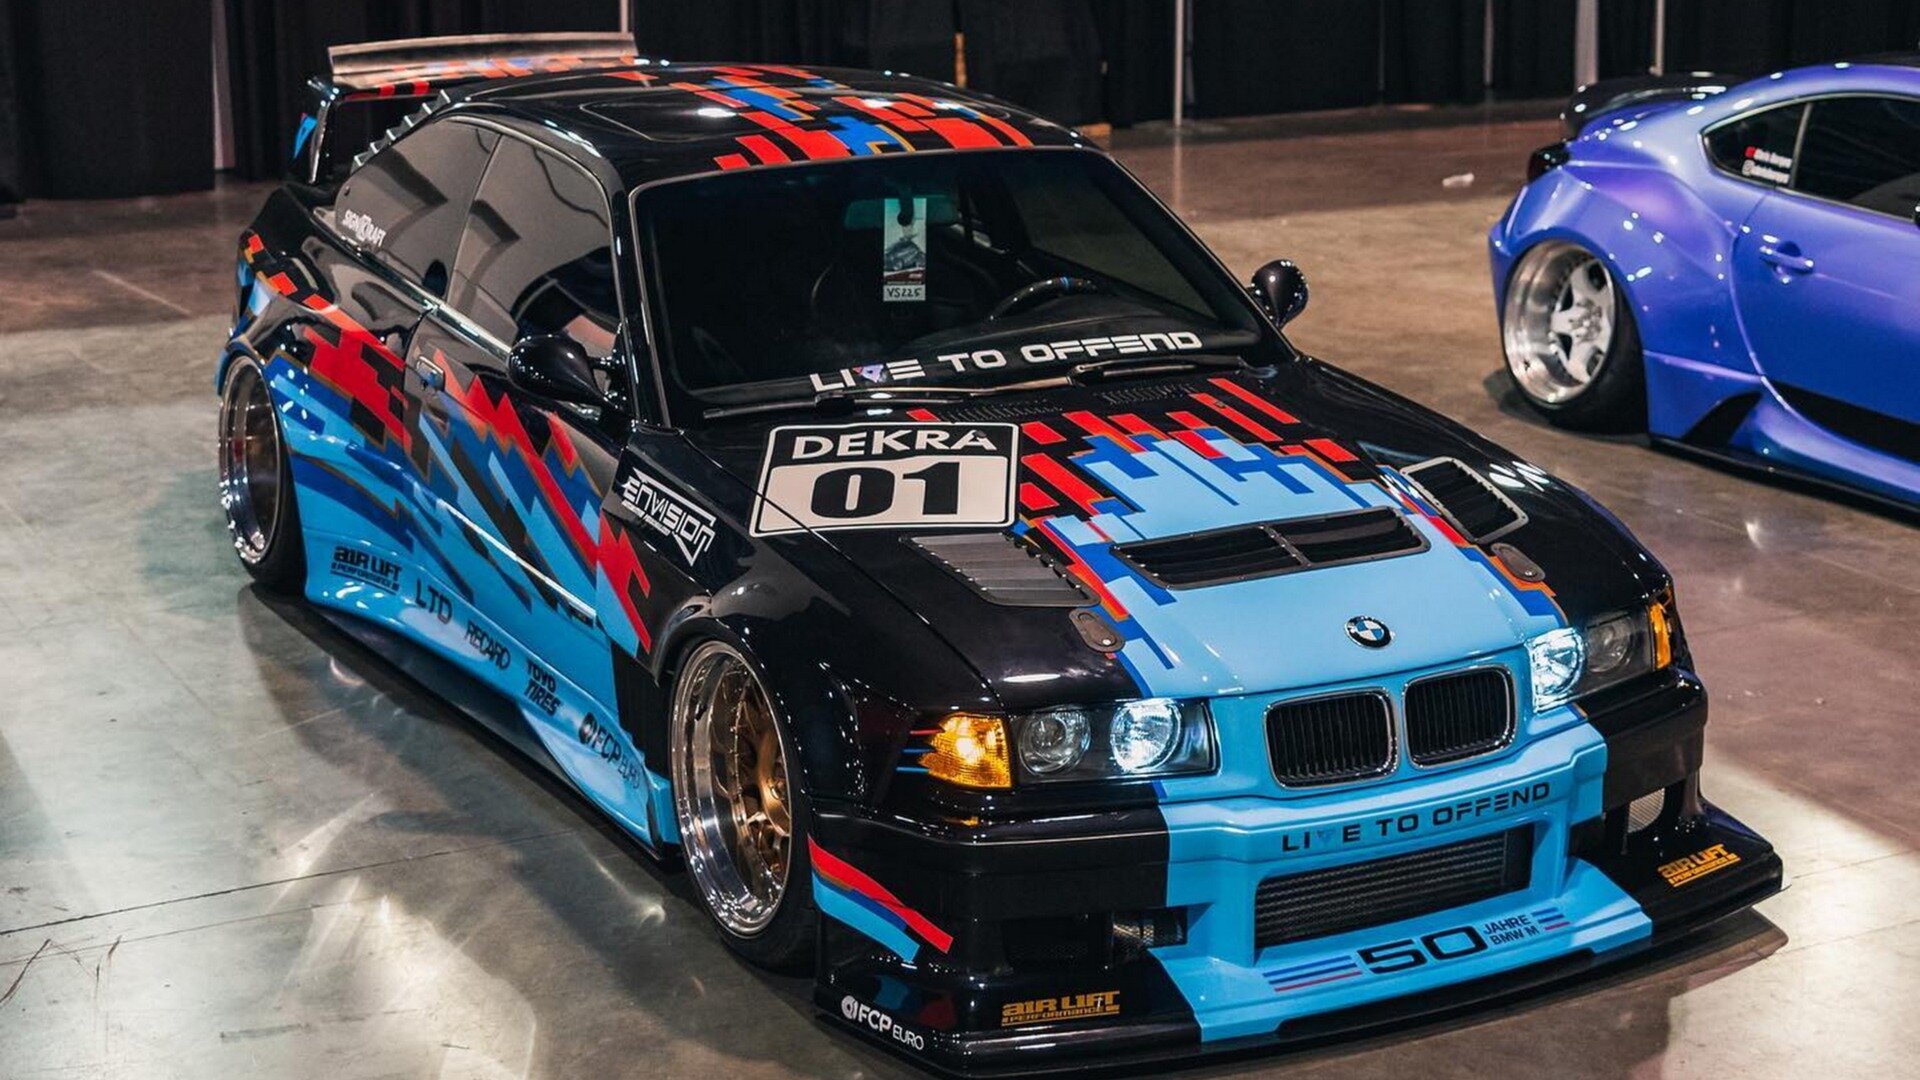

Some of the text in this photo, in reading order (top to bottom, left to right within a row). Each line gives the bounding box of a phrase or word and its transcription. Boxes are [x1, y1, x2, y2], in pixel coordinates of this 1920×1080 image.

[937, 349, 1007, 372] TO
[1020, 331, 1203, 363] OFFEND
[792, 429, 997, 460] DEKRA
[811, 461, 961, 520] 01
[622, 473, 716, 556] ENVISION
[371, 555, 403, 583] LIFT
[414, 578, 454, 625] LTD
[465, 620, 511, 670] RECARO
[526, 659, 557, 693] TOYO
[524, 679, 562, 717] TIRES
[592, 727, 622, 763] FCP
[1376, 814, 1419, 836] TO
[1432, 782, 1550, 825] OFFEND
[1690, 843, 1728, 865] LIFT
[1483, 914, 1531, 935] JAHRE
[1489, 925, 1540, 945] BMW M
[1357, 926, 1489, 975] 50
[1062, 989, 1120, 1010] LIFT
[858, 1003, 925, 1051] FCP EURO
